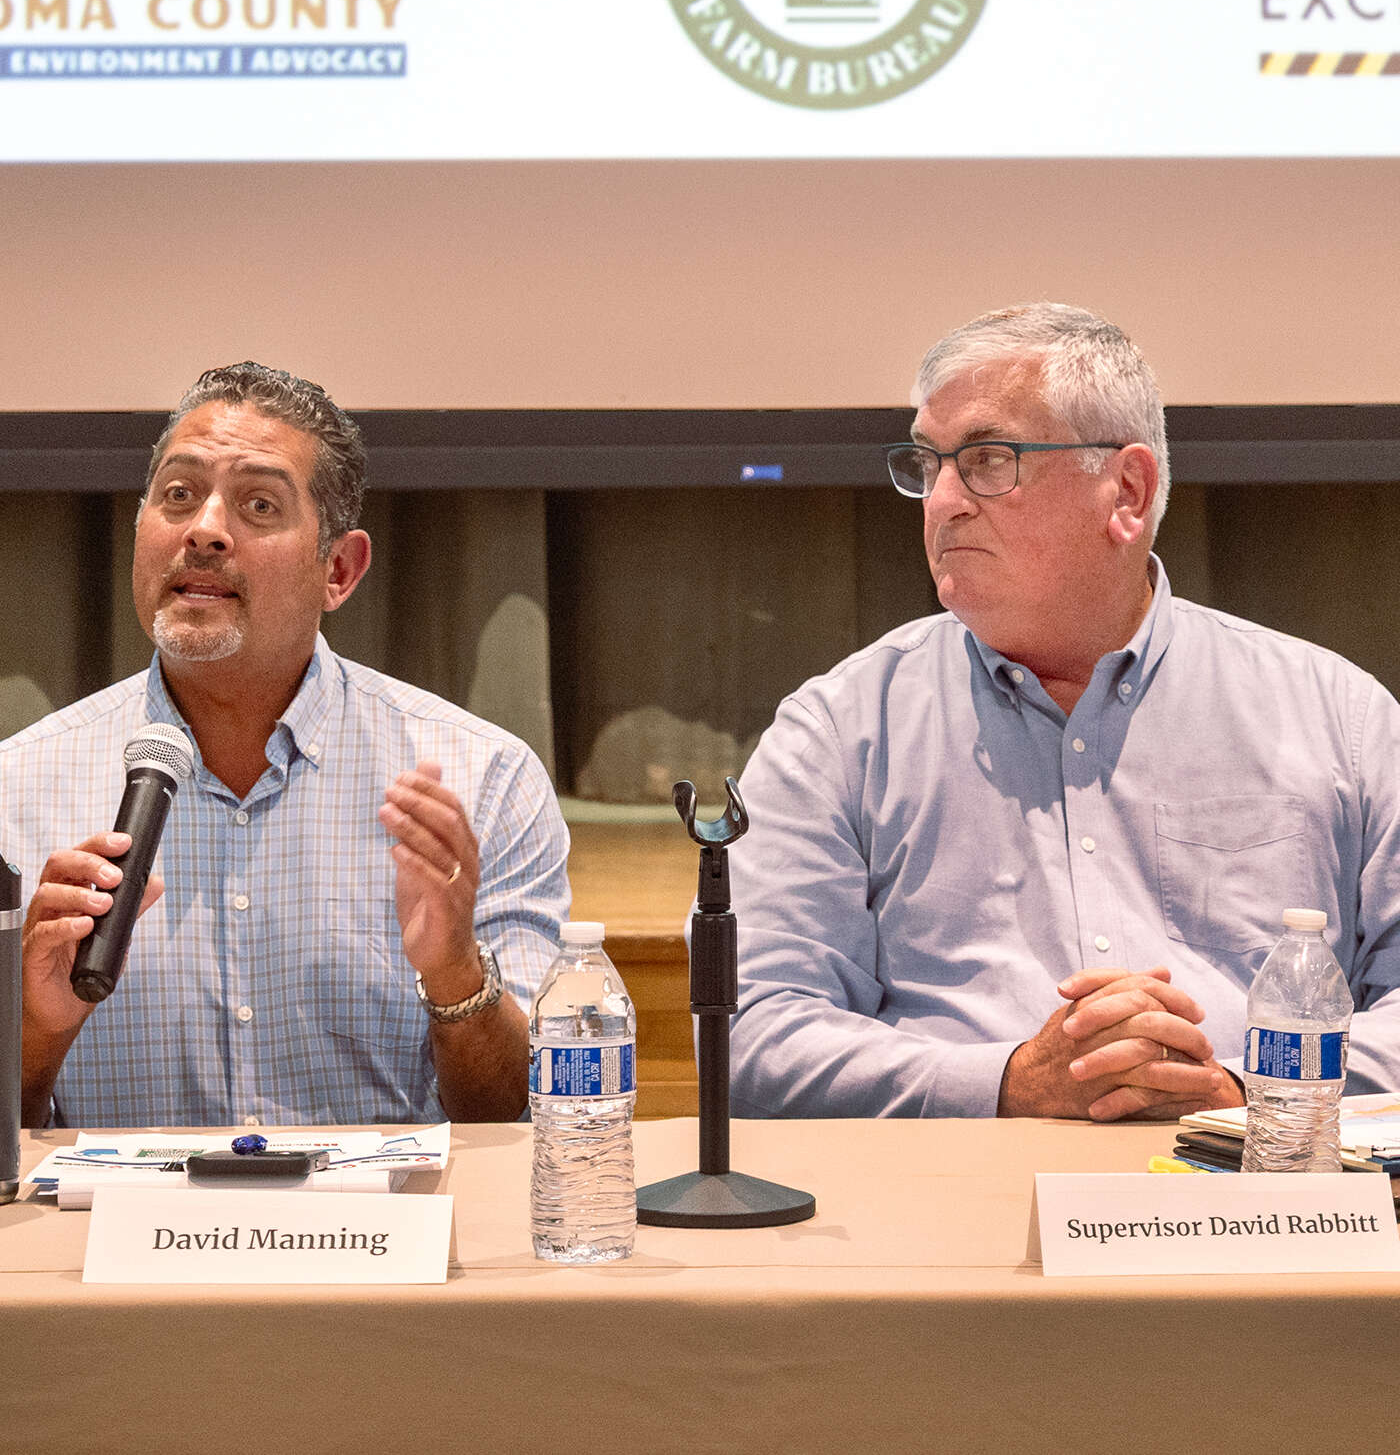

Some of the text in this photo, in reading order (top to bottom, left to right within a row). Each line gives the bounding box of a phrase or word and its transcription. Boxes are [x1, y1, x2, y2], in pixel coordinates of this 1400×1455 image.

[9, 47, 221, 74] ENVIRONMENT
[250, 47, 404, 73] ADVOCACY
[152, 1227, 389, 1256] David Manning
[1067, 1212, 1380, 1244] Supervisor David Rabbitt
